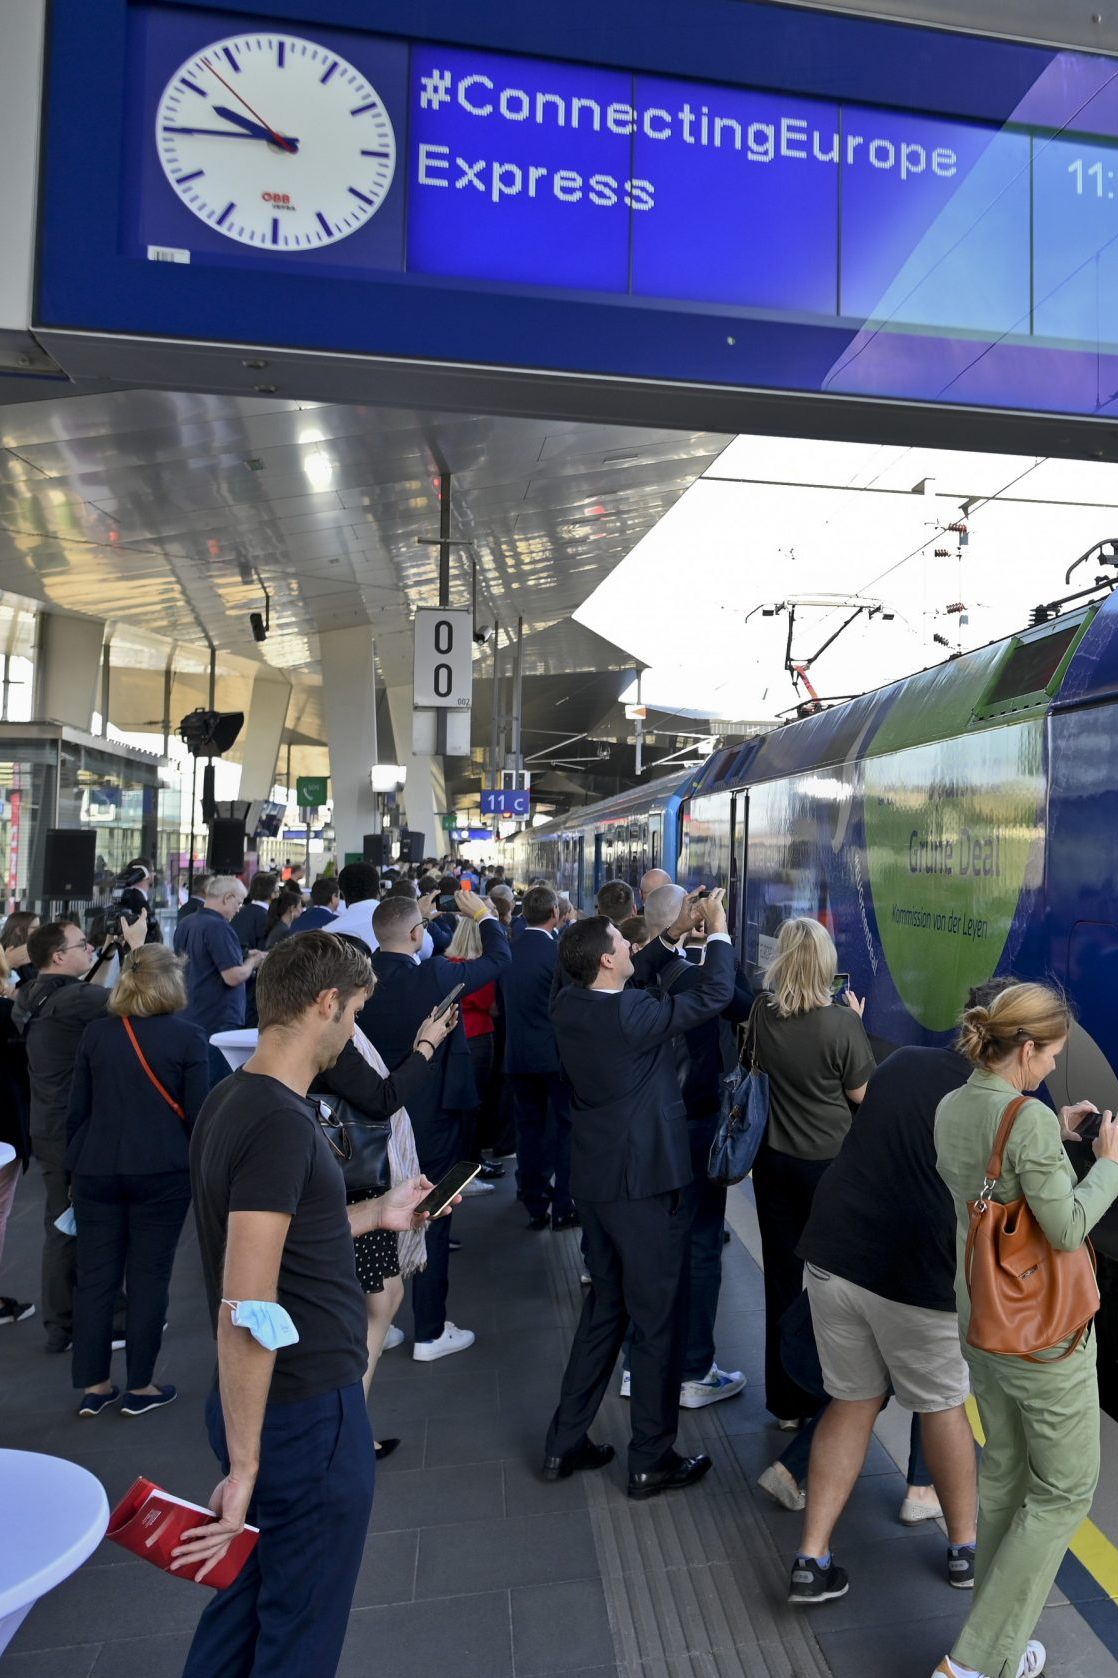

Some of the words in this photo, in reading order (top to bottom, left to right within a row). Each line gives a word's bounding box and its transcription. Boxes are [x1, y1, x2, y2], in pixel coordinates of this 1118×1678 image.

[420, 68, 957, 180] #ConnectingEurope
[418, 143, 655, 211] Express
[434, 620, 453, 655] 0
[433, 663, 452, 698] 0
[488, 795, 505, 811] 11
[959, 826, 1001, 877] Deal
[892, 904, 932, 930] Kommission
[933, 914, 947, 932] von
[948, 909, 961, 934] der
[962, 911, 989, 942] Leyen
